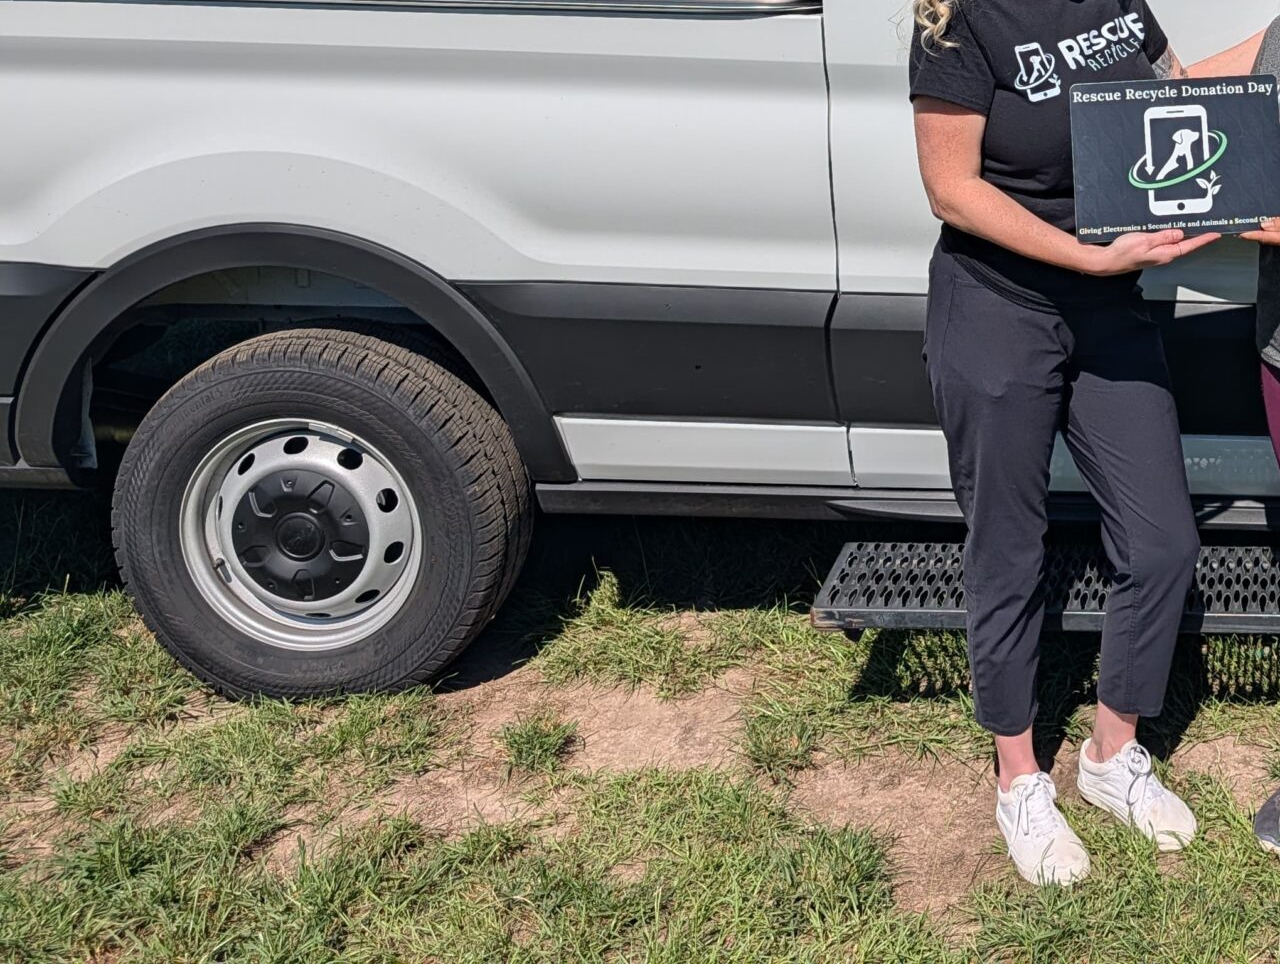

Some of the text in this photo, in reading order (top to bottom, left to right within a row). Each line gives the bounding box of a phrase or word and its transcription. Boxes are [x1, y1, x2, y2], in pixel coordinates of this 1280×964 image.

[1057, 12, 1145, 72] RESCUE RECYCLE
[1072, 82, 1273, 103] Rescue Recycle Donation Day
[1079, 227, 1102, 235] Giving
[1103, 225, 1141, 233] Electronics
[1147, 222, 1171, 230] Second
[1201, 218, 1228, 226] Animals
[1234, 216, 1258, 224] Second
